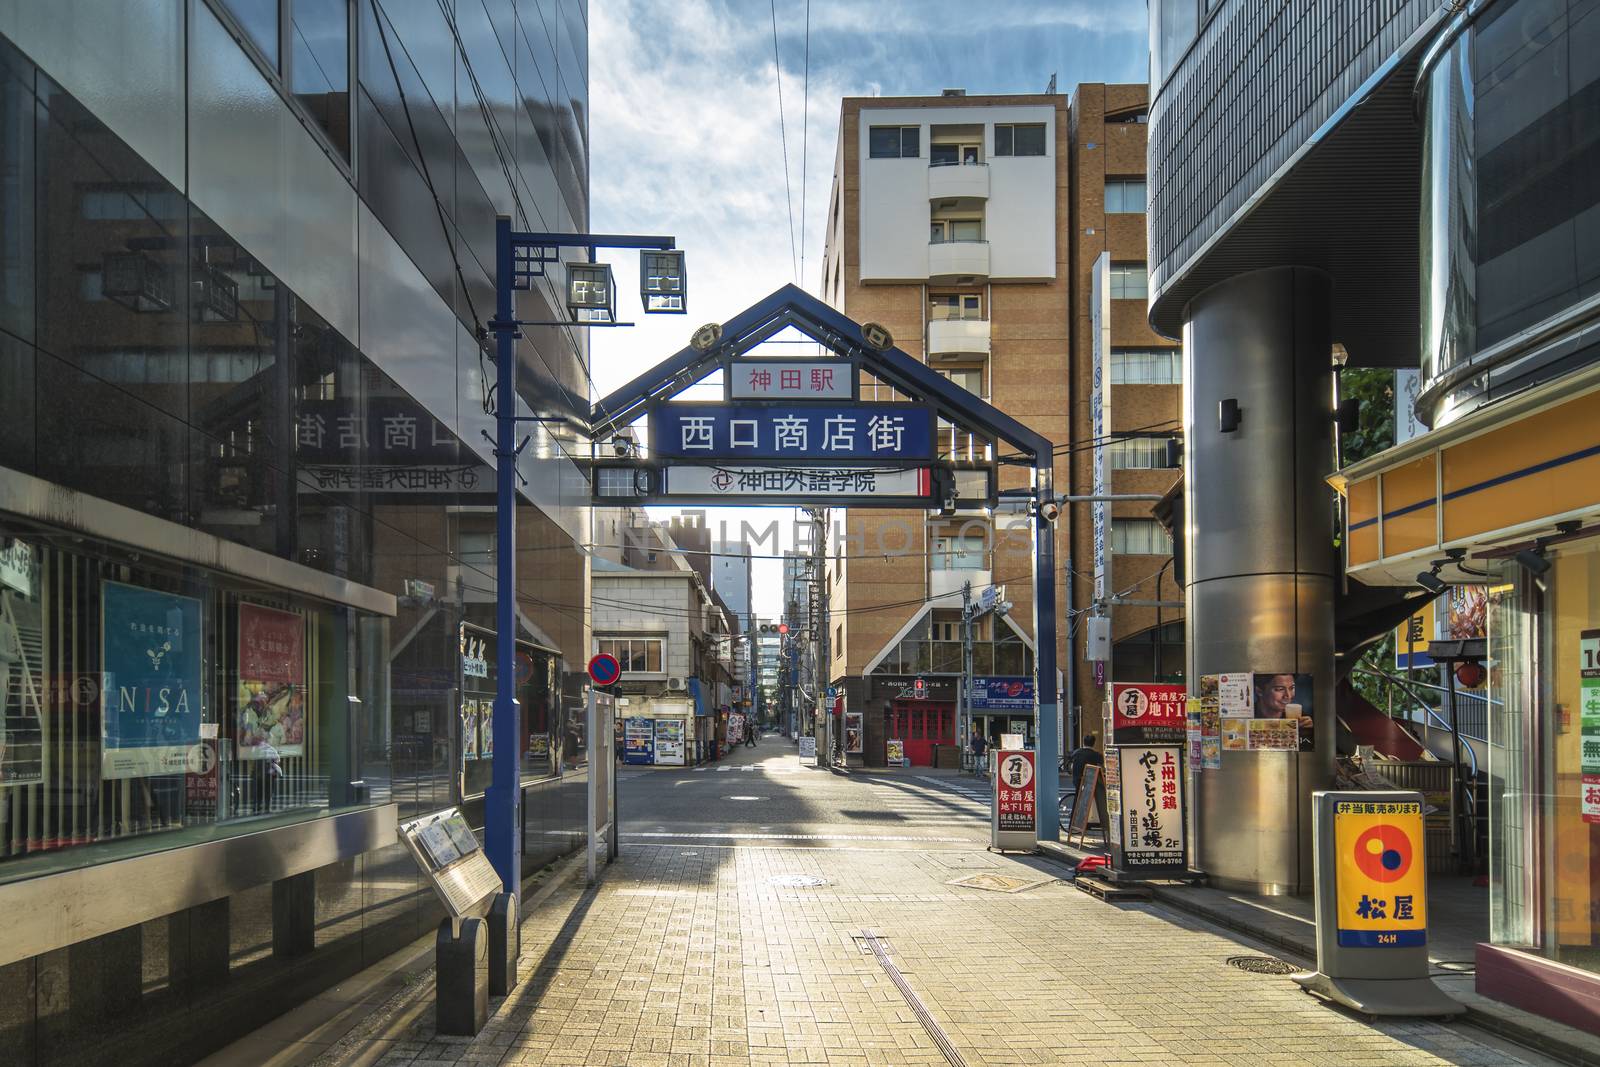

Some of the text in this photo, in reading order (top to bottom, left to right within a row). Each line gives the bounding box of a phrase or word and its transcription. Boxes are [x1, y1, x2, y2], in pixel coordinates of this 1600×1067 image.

[748, 368, 835, 392] 神田駅
[679, 414, 905, 452] 西口商店街
[737, 468, 876, 492] 神田外語学院
[119, 686, 190, 713] NISA
[1125, 690, 1140, 716] 万屋
[1149, 702, 1188, 717] 地下1
[1008, 758, 1022, 785] 万屋
[1161, 752, 1177, 810] 上州地鶏
[999, 790, 1034, 802] 居酒屋
[1001, 803, 1033, 812] 地下1階
[1139, 751, 1163, 848] やきとり道場
[1340, 803, 1419, 814] 弁当販売あります
[1130, 809, 1138, 848] 神田西口店
[1165, 839, 1180, 848] 2F
[1356, 895, 1414, 920] 松屋
[1378, 935, 1397, 944] 24H
